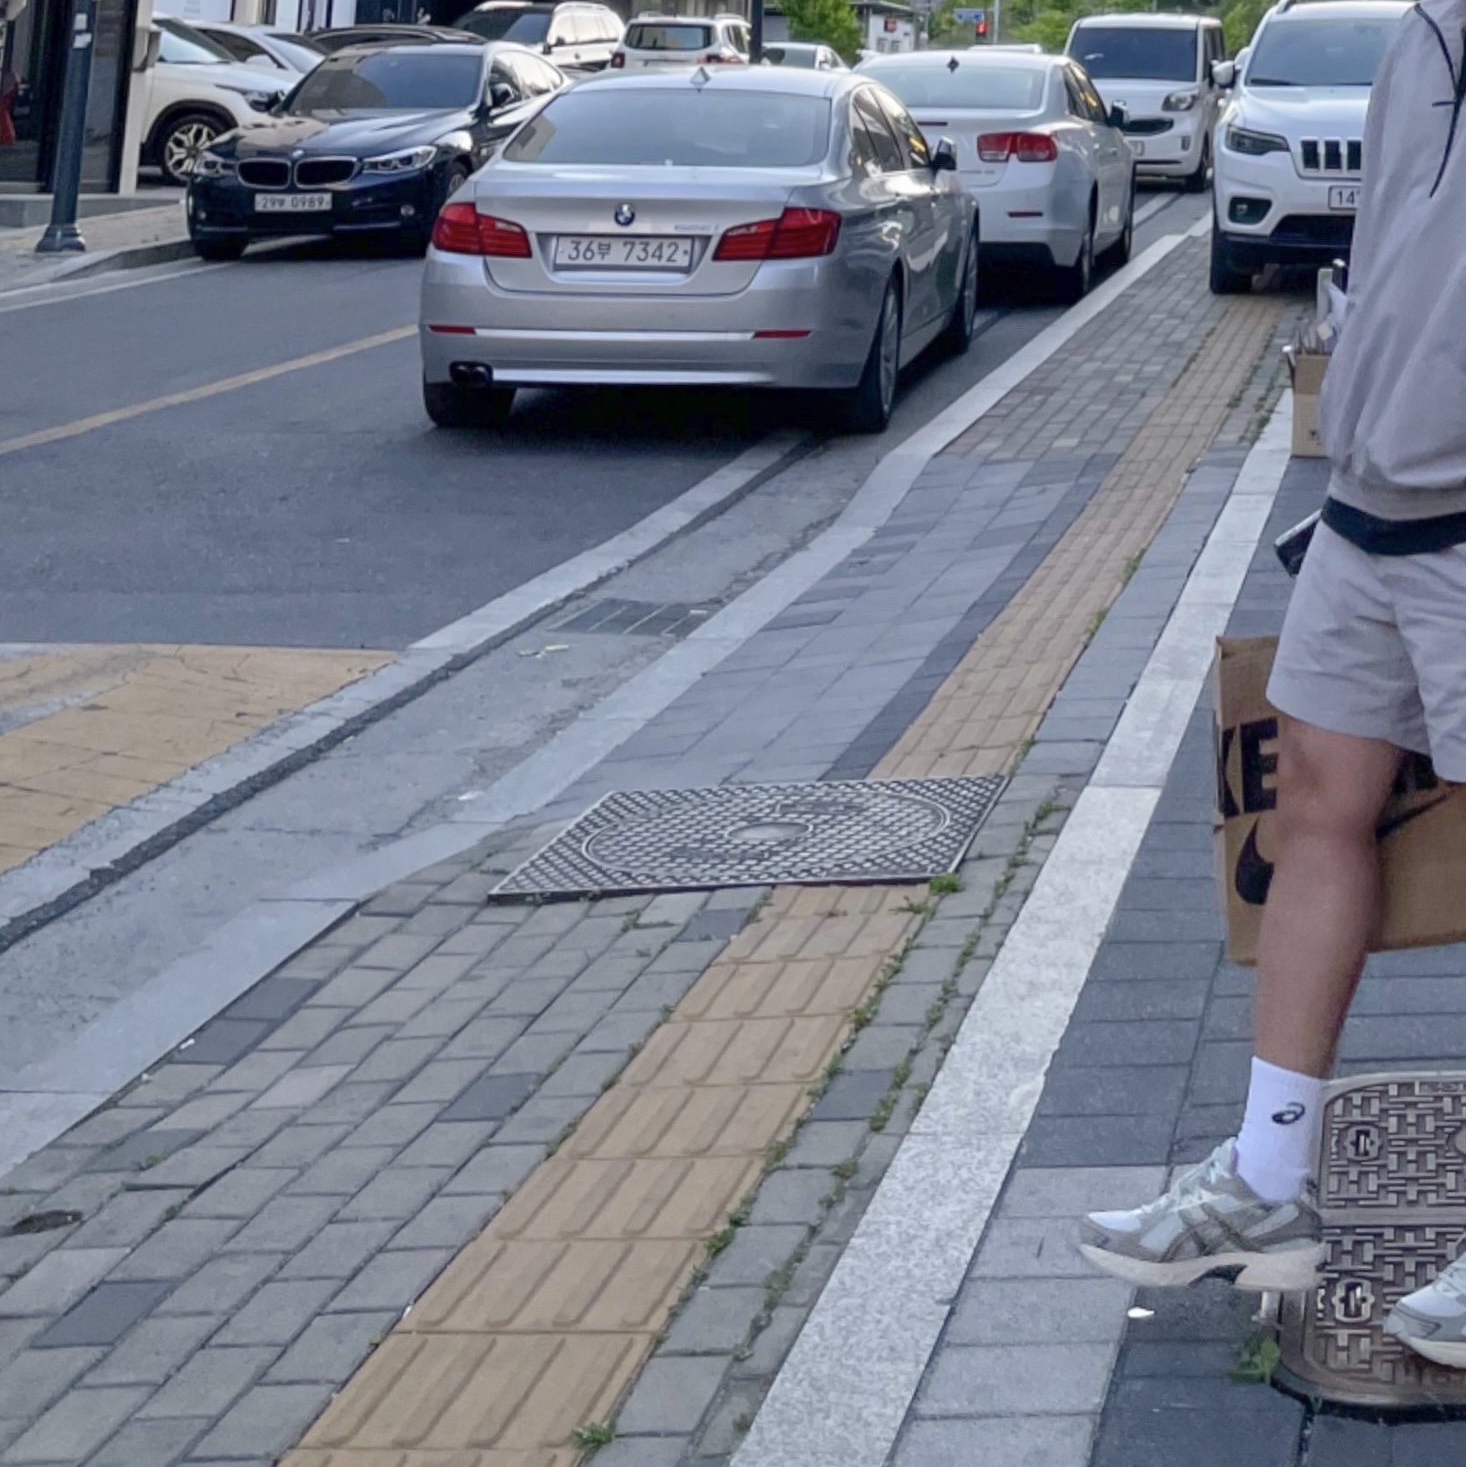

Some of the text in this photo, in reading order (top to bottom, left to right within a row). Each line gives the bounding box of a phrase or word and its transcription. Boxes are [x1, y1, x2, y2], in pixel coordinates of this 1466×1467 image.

[1338, 190, 1361, 205] 14
[567, 240, 680, 263] 36부 7342
